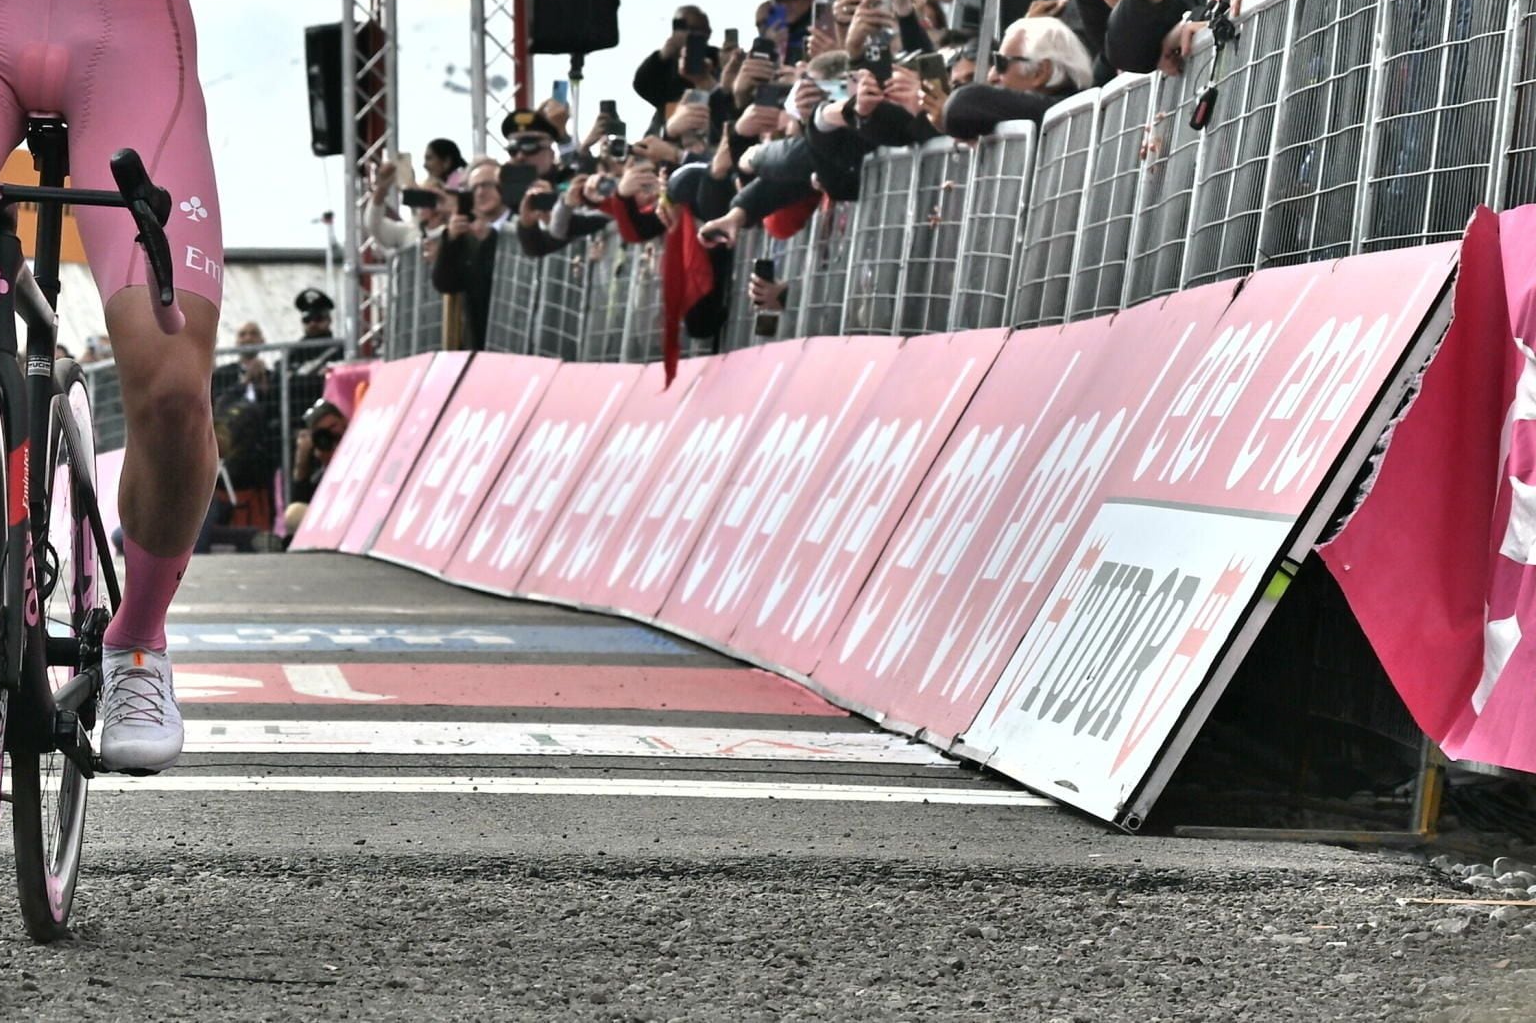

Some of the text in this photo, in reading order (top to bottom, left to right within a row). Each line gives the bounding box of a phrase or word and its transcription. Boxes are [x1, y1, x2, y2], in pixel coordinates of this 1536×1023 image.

[393, 375, 541, 550] enel
[466, 379, 624, 571] enel
[538, 375, 704, 582] enel
[607, 361, 785, 593] enel
[681, 360, 876, 615] enel
[1133, 275, 1318, 485] enel
[1226, 260, 1438, 495] enel
[756, 358, 976, 643] enel
[839, 350, 1081, 678] enel
[919, 322, 1197, 704] enel
[1020, 560, 1201, 742] TUDOR
